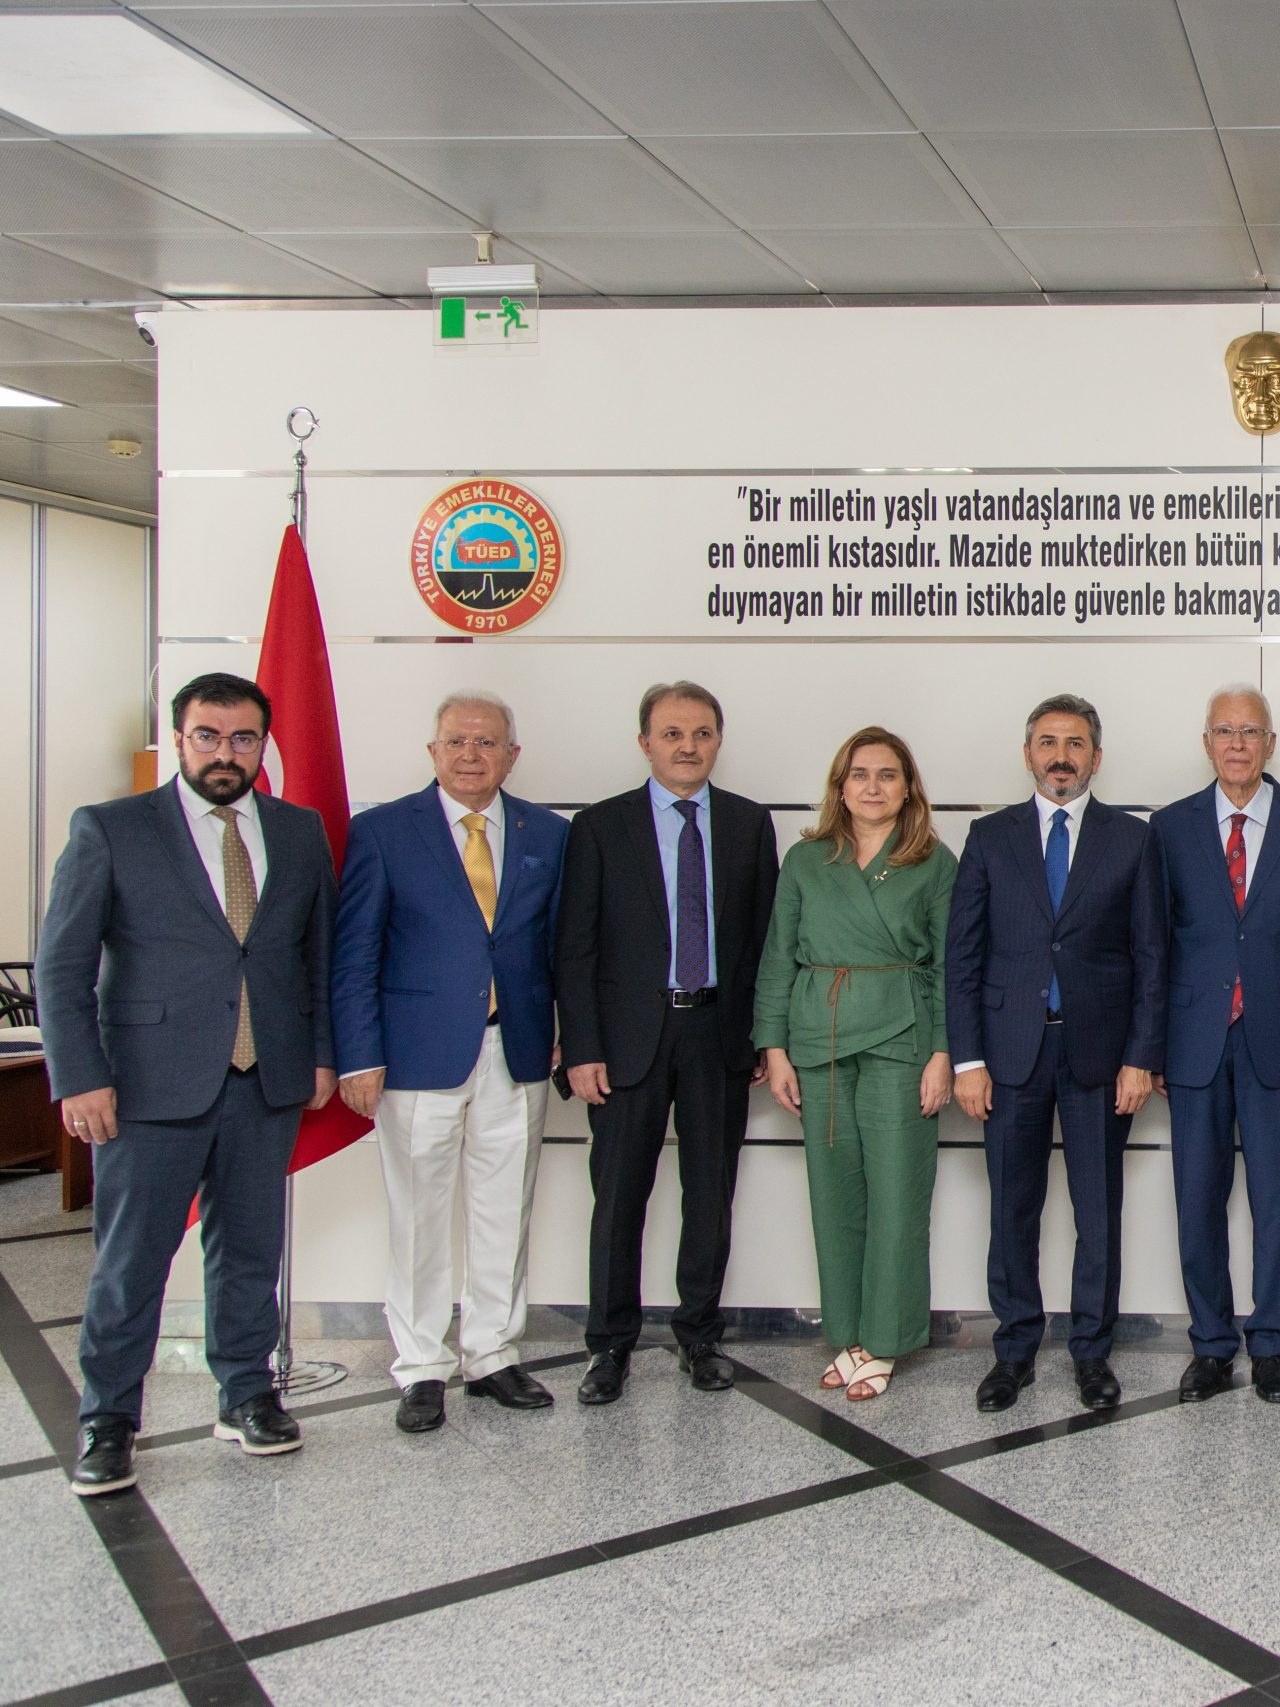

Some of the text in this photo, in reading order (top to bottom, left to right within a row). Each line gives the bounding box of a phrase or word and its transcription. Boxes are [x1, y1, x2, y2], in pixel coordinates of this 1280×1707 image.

[790, 488, 875, 522] milletin
[884, 488, 937, 531] yaşlı
[946, 487, 1120, 531] vatandaşlarına
[1129, 494, 1154, 520] ve
[414, 484, 556, 605] TÜRKİYE EMEKLİLER DERNEĞİ
[465, 544, 511, 559] TÜED
[708, 542, 734, 568] en
[744, 535, 819, 568] önemli
[829, 535, 940, 568] kıstasıdır.
[950, 534, 1031, 567] Mazide
[1042, 533, 1186, 567] muktedirken
[1196, 533, 1262, 567] bütün
[465, 614, 508, 629] 1970
[708, 584, 822, 624] duymayan
[833, 583, 862, 616] bir
[872, 583, 957, 616] milletin
[967, 583, 1065, 616] istikbale
[1075, 582, 1165, 624] güvenle
[1175, 582, 1280, 623] bakmaya
